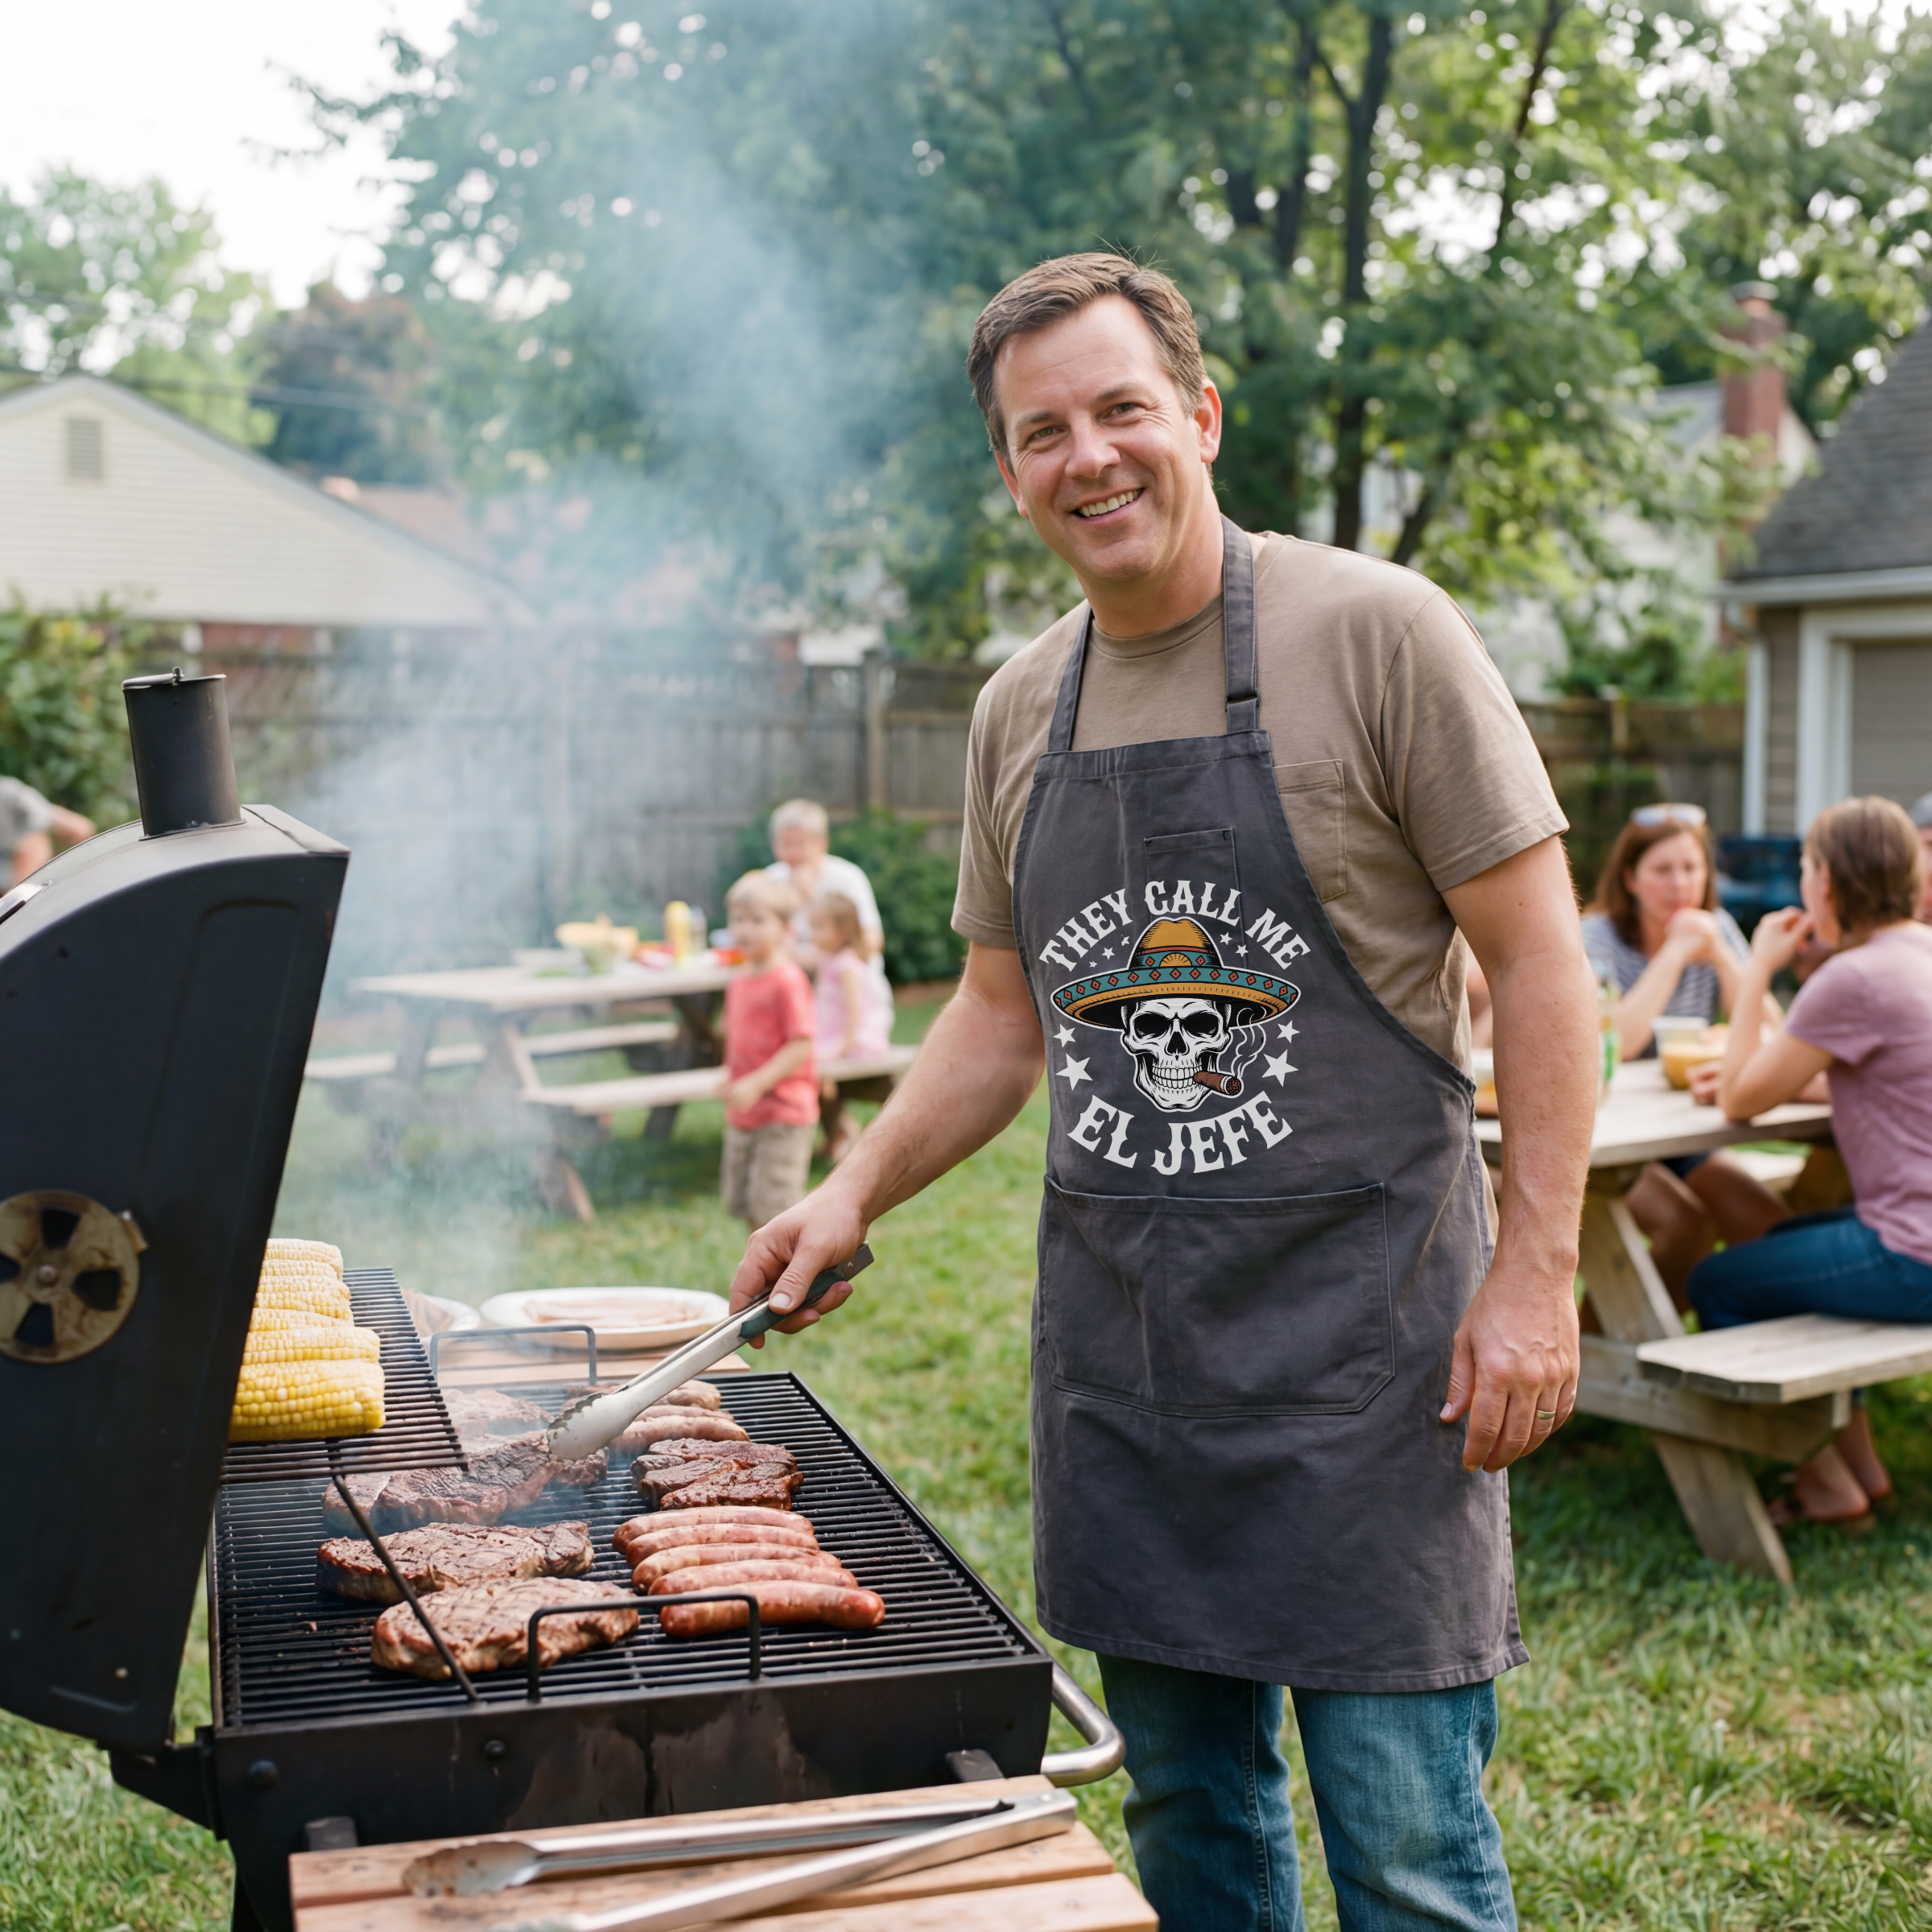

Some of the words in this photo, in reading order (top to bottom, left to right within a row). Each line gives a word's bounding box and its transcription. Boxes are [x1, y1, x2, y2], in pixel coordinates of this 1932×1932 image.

[1038, 888, 1133, 972] THEY
[1144, 880, 1242, 927] CALL
[1245, 907, 1311, 970] ME
[1067, 1094, 1138, 1169] EL
[1150, 1090, 1294, 1176] JEFE
